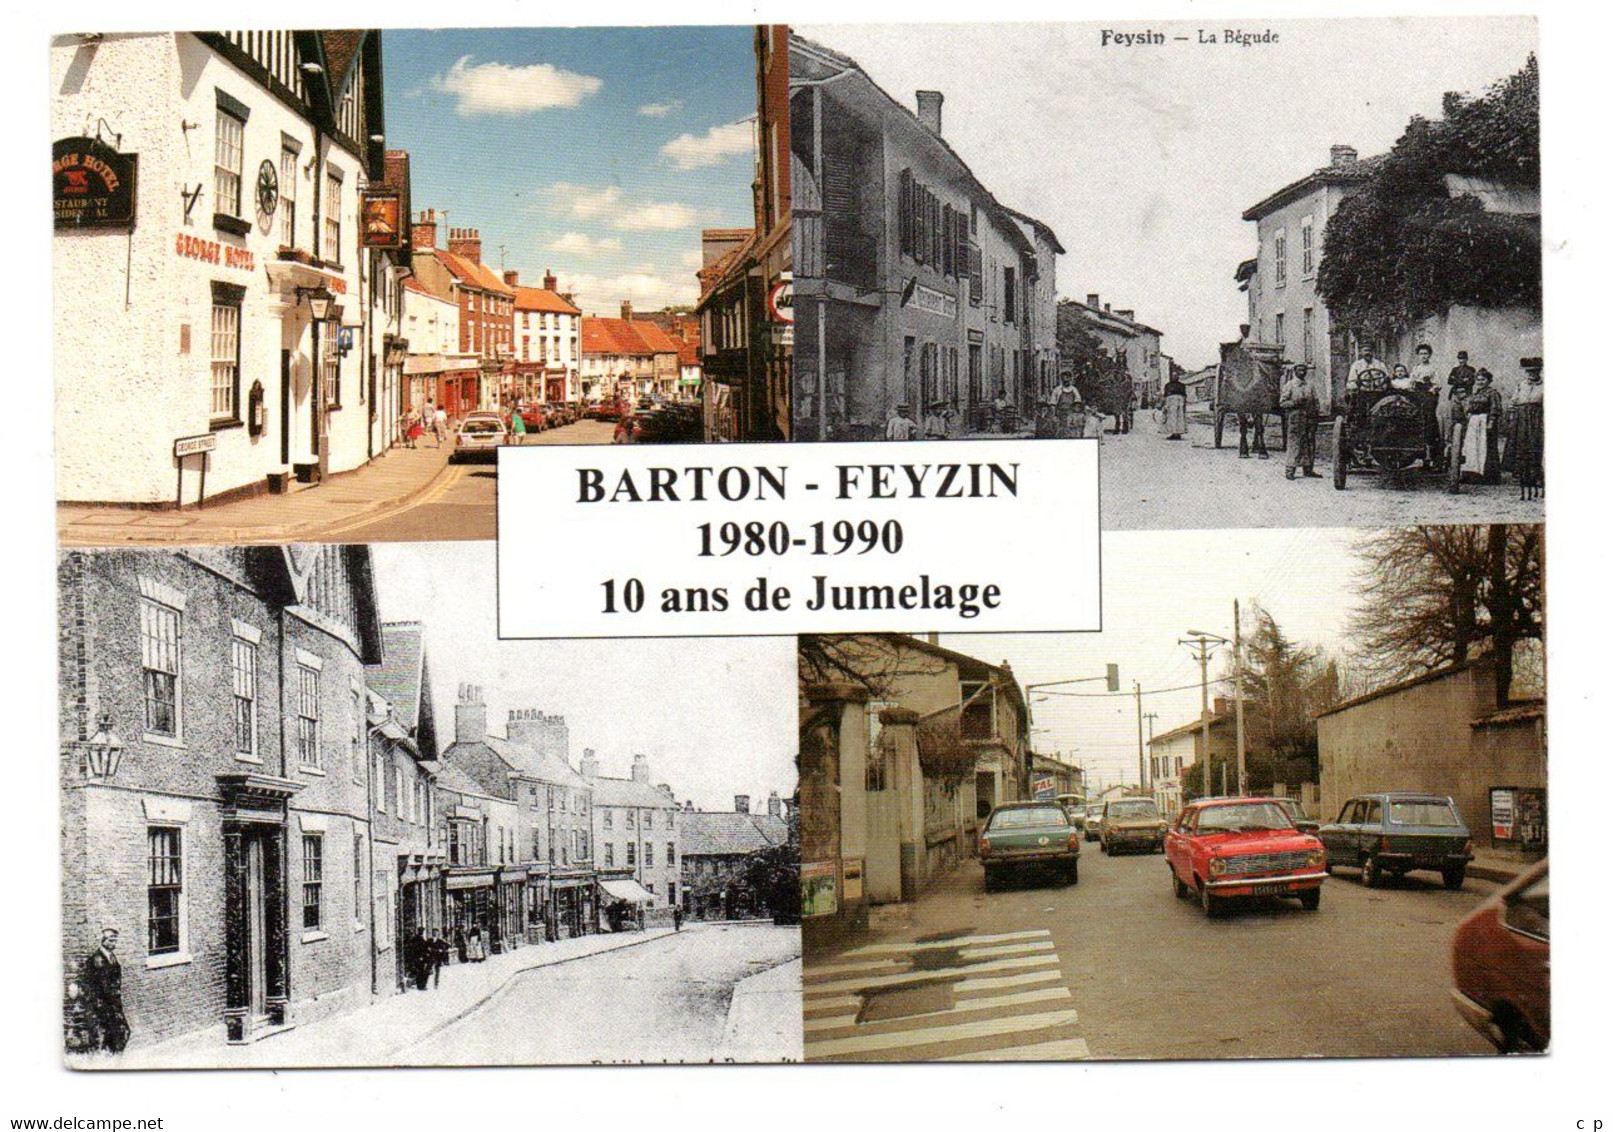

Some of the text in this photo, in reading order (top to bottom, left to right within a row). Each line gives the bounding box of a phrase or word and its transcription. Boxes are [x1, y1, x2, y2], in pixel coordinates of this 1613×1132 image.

[1102, 30, 1164, 46] Feysin
[1199, 30, 1216, 43] La
[1225, 30, 1278, 46] Bégude
[82, 154, 120, 193] HOTEL
[175, 233, 256, 272] GEORGE HOTEL
[577, 467, 787, 502] BARTON
[836, 464, 1018, 498] FEYZIN
[698, 520, 902, 556] 1980-1990
[603, 576, 1000, 618] 10 ans de Jumelage
